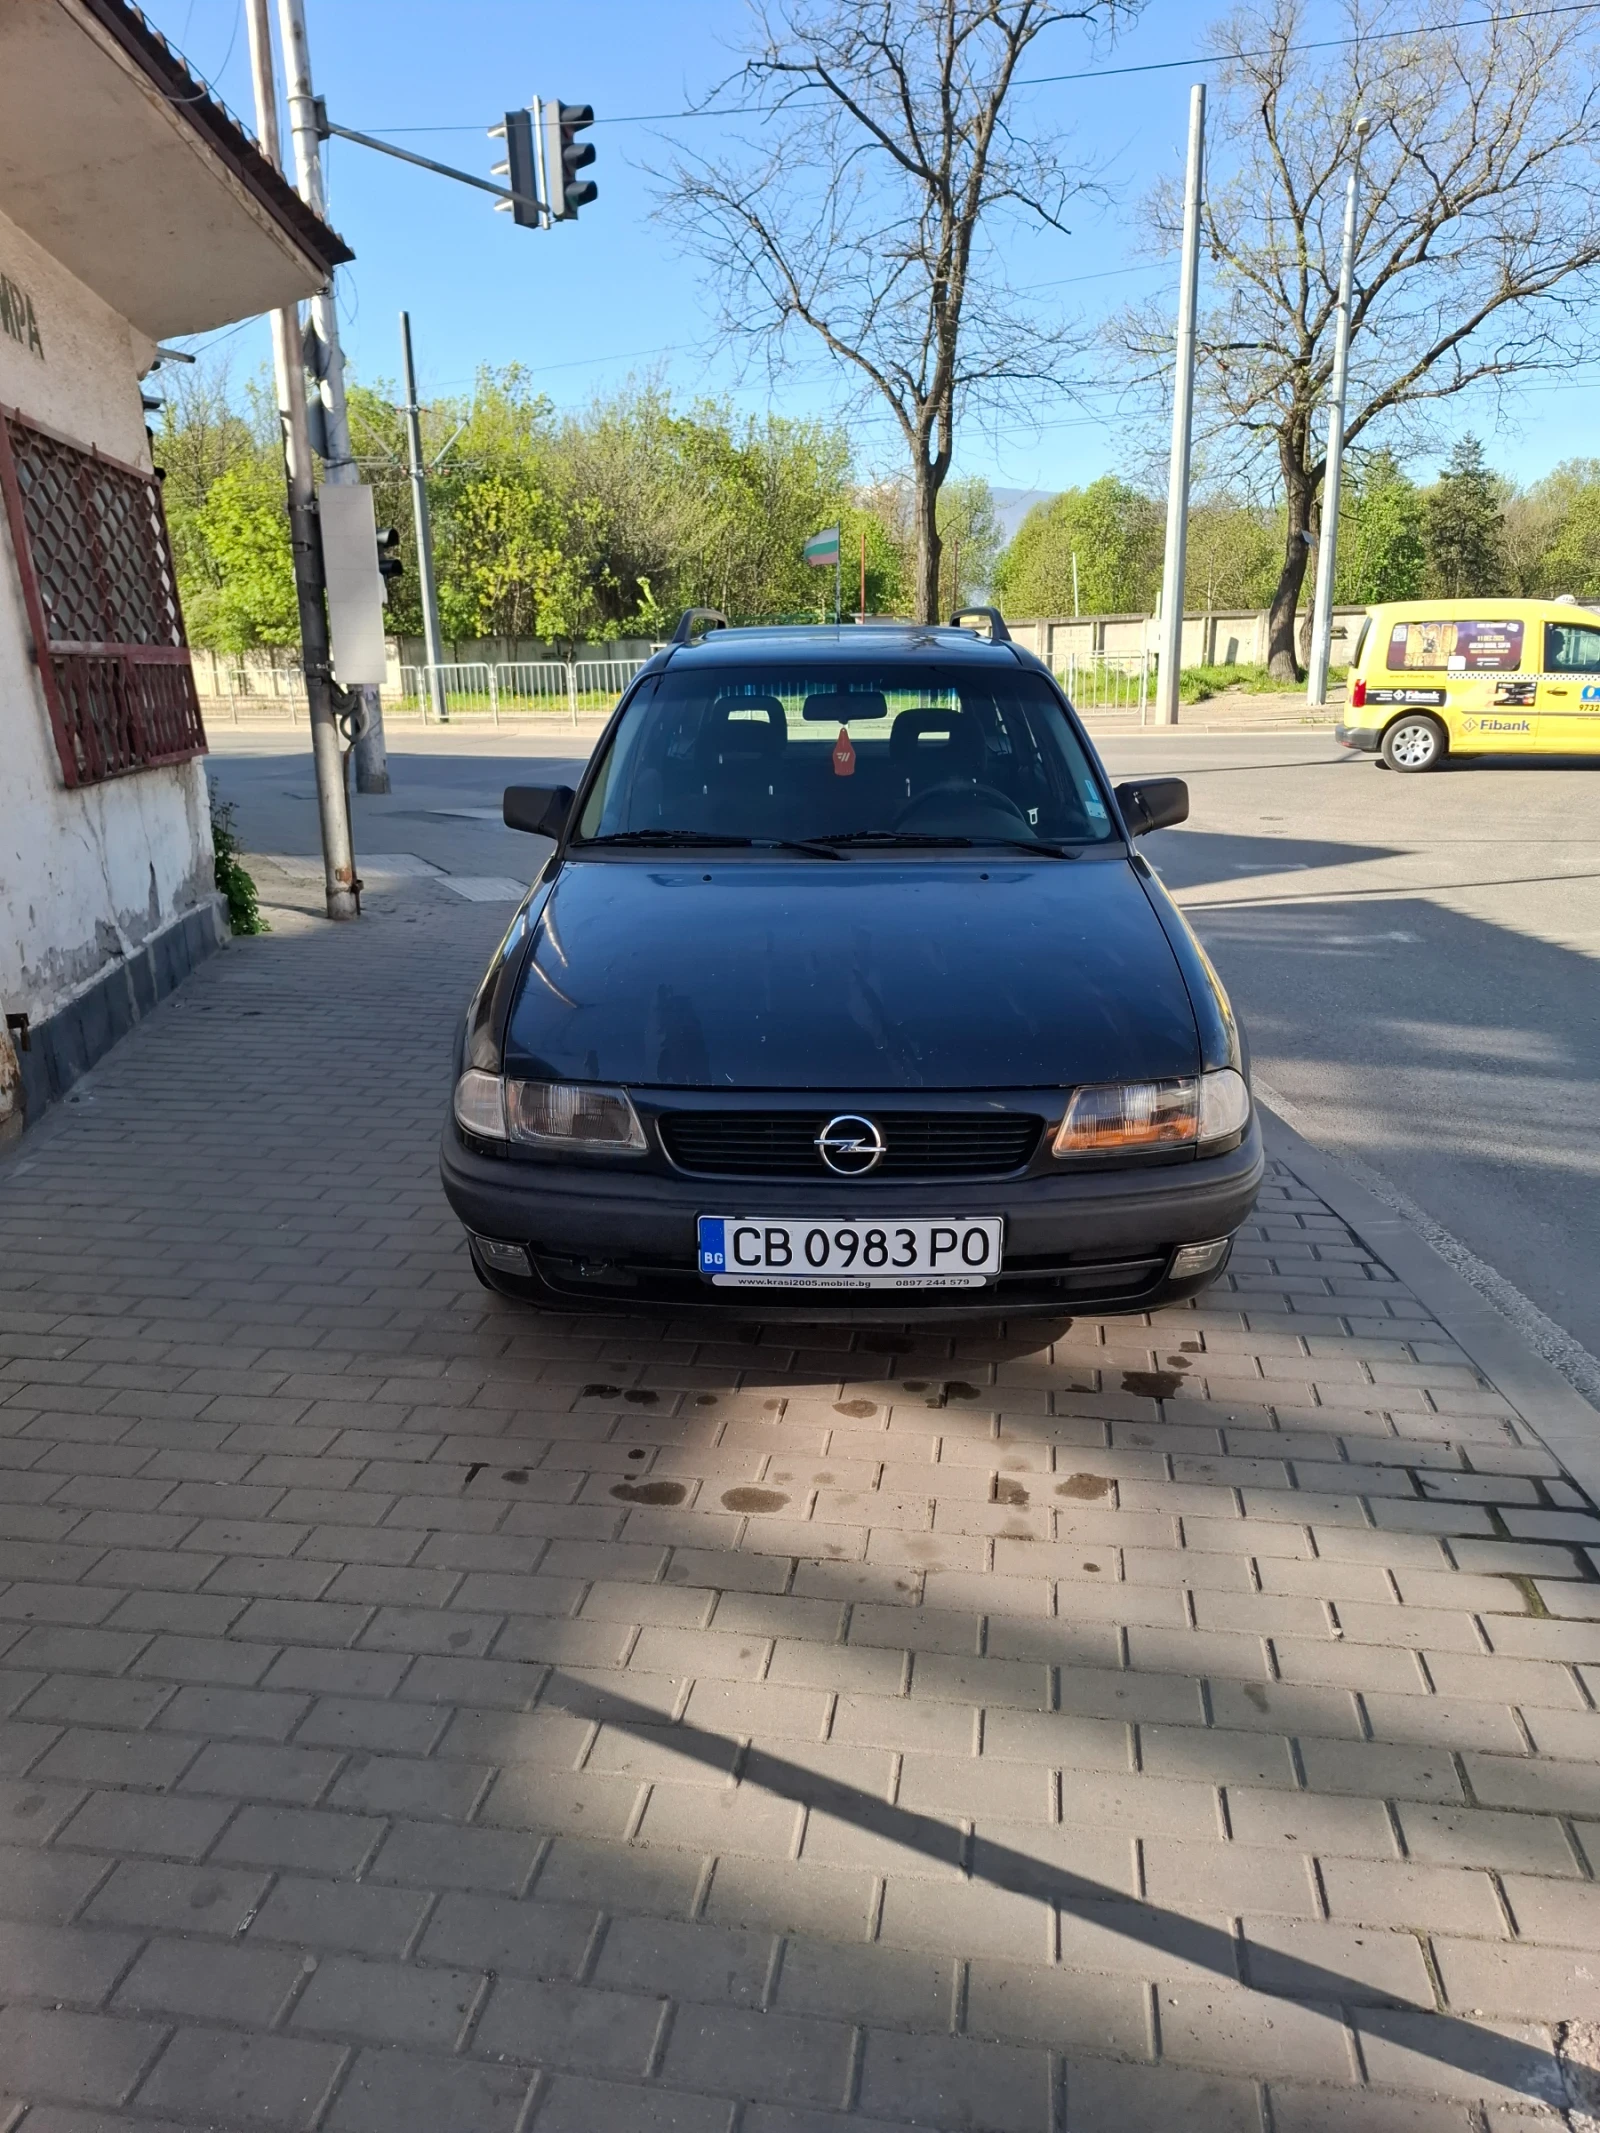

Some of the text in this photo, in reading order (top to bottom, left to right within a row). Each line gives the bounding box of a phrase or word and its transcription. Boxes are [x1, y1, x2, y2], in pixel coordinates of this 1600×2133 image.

[1480, 720, 1531, 731] Fibank
[704, 1252, 724, 1265] BG
[733, 1227, 793, 1266] CB
[804, 1228, 918, 1267] 0983
[738, 1278, 871, 1288] www.krasi2005.mobile.bg
[949, 1278, 970, 1286] 579
